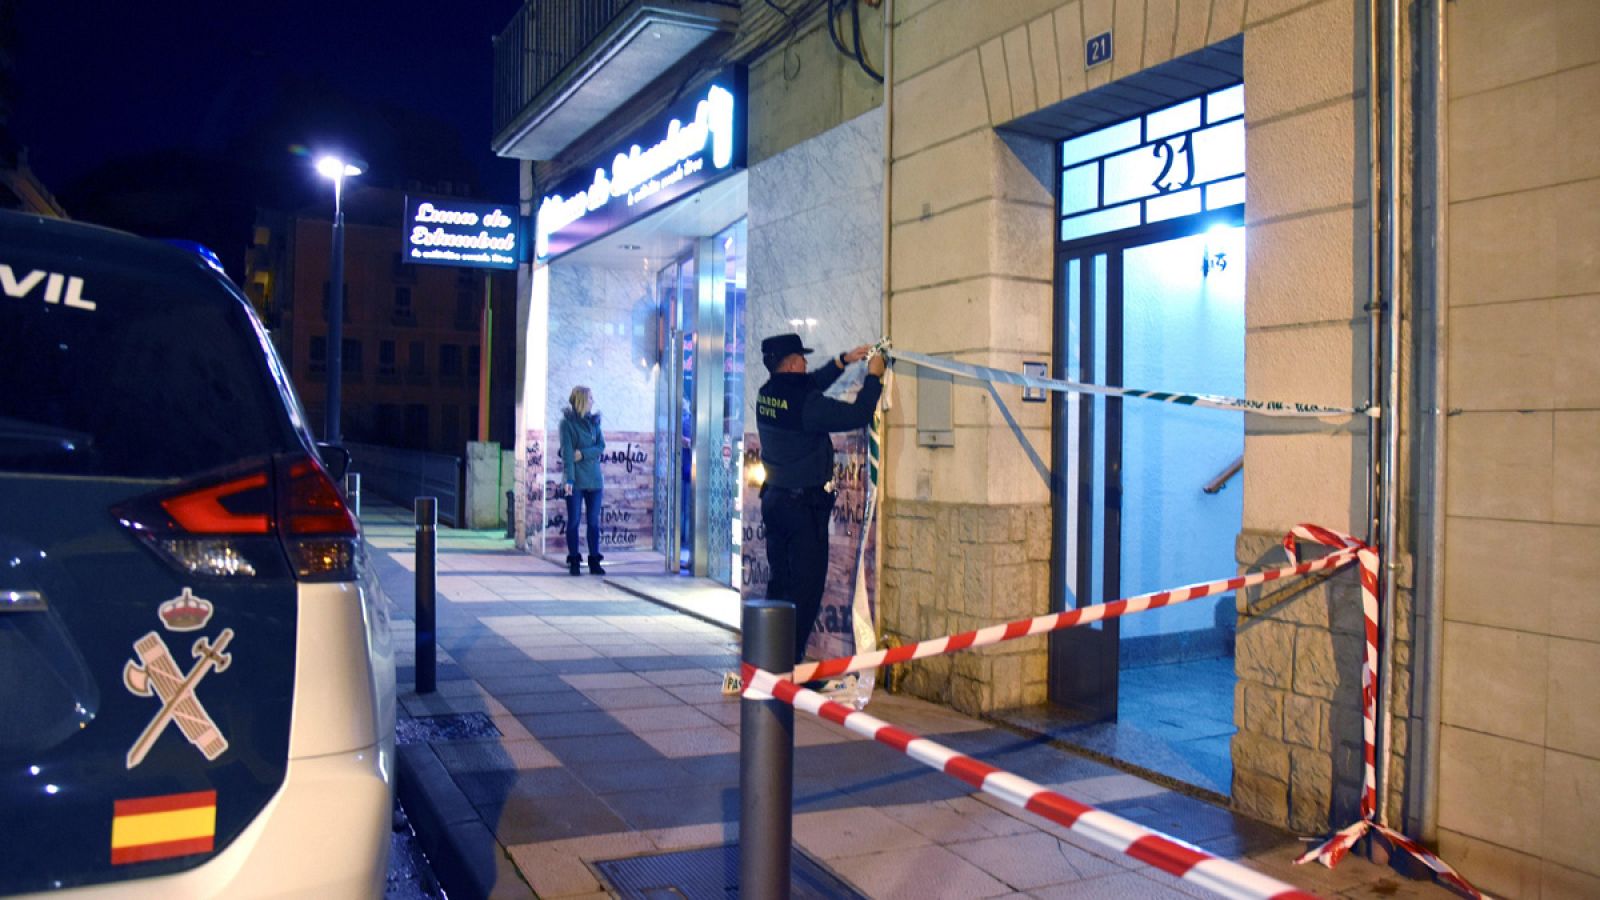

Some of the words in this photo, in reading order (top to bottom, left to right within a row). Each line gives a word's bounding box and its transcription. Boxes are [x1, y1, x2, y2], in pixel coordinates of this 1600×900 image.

[1091, 37, 1106, 61] 21
[1151, 132, 1196, 194] 21
[0, 264, 97, 311] VIL
[760, 405, 777, 418] CIVIL
